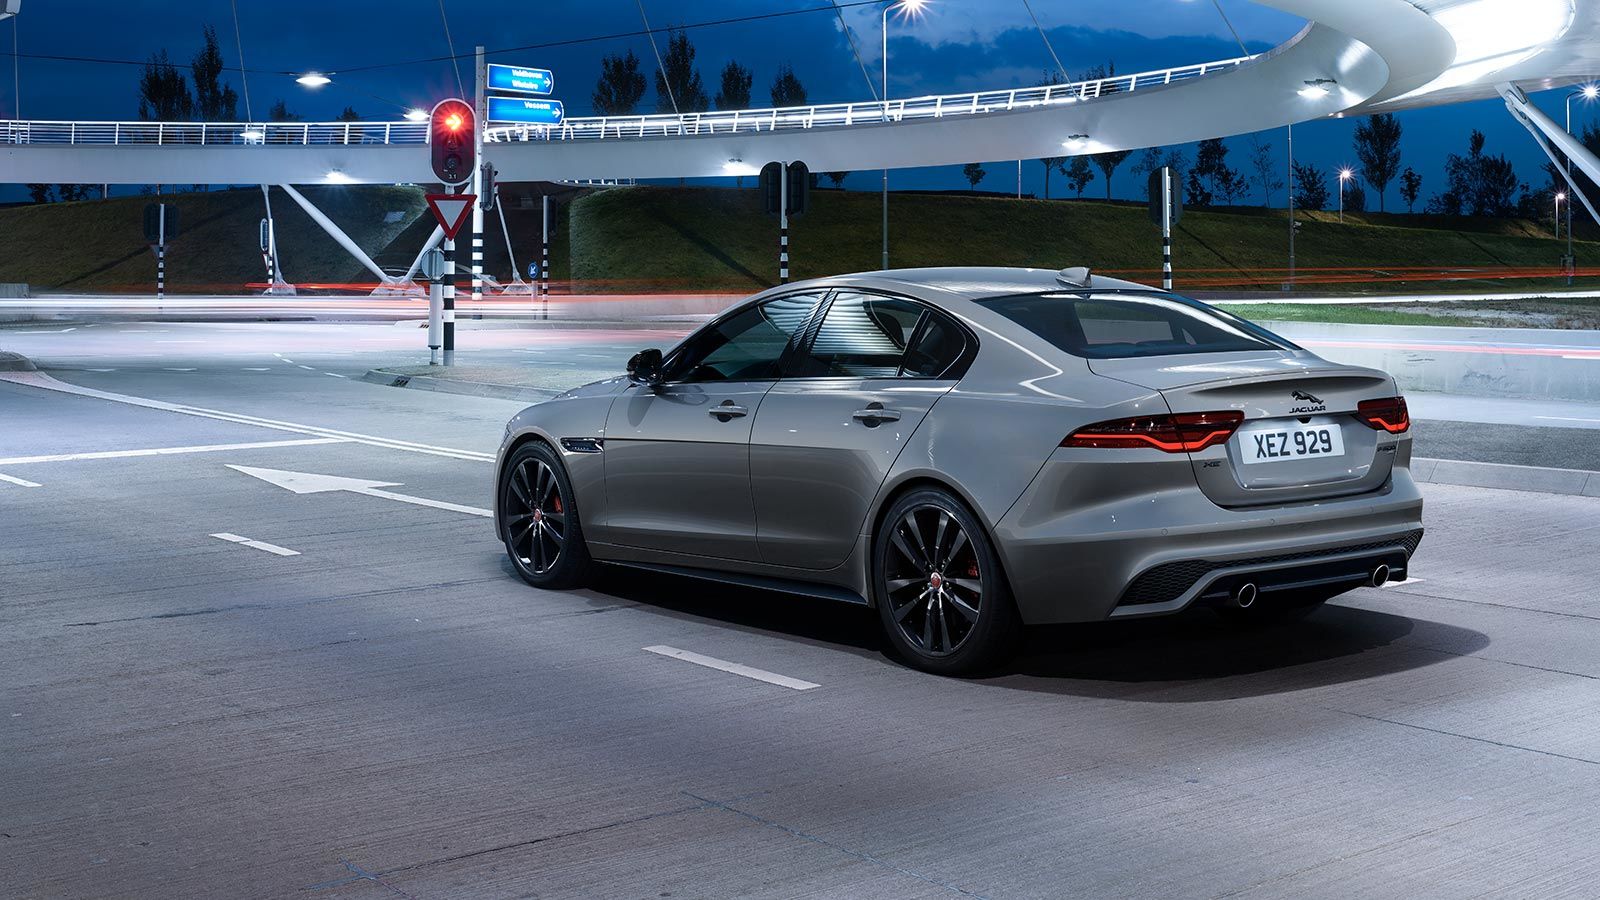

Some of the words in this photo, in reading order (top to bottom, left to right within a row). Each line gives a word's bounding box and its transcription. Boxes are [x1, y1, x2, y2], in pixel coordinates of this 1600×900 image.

[524, 101, 550, 110] Vessem
[1289, 405, 1326, 414] JAGUAR
[1254, 432, 1290, 459] XEZ
[1294, 429, 1333, 455] 929
